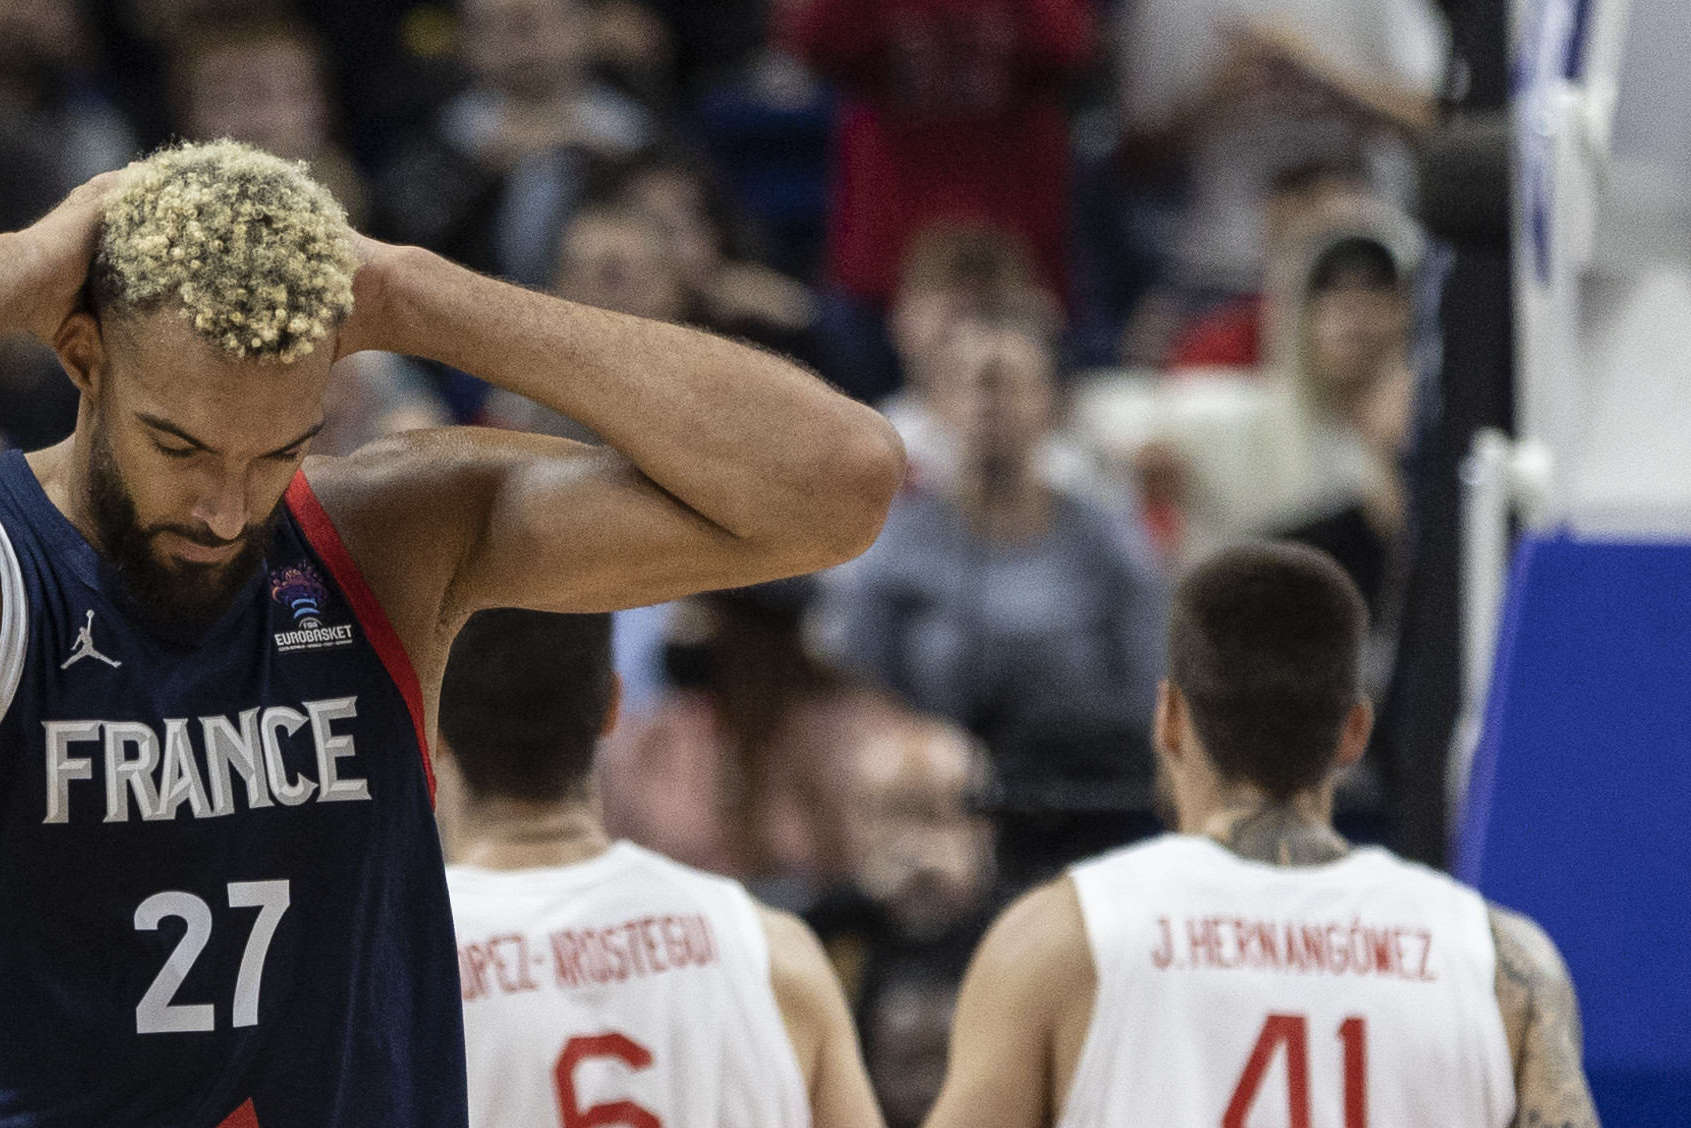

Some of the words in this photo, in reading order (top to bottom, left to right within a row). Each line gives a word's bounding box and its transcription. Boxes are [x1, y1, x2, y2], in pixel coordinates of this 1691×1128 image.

[273, 624, 352, 646] EUROBASKET
[41, 695, 373, 824] FRANCE
[133, 879, 290, 1034] 27
